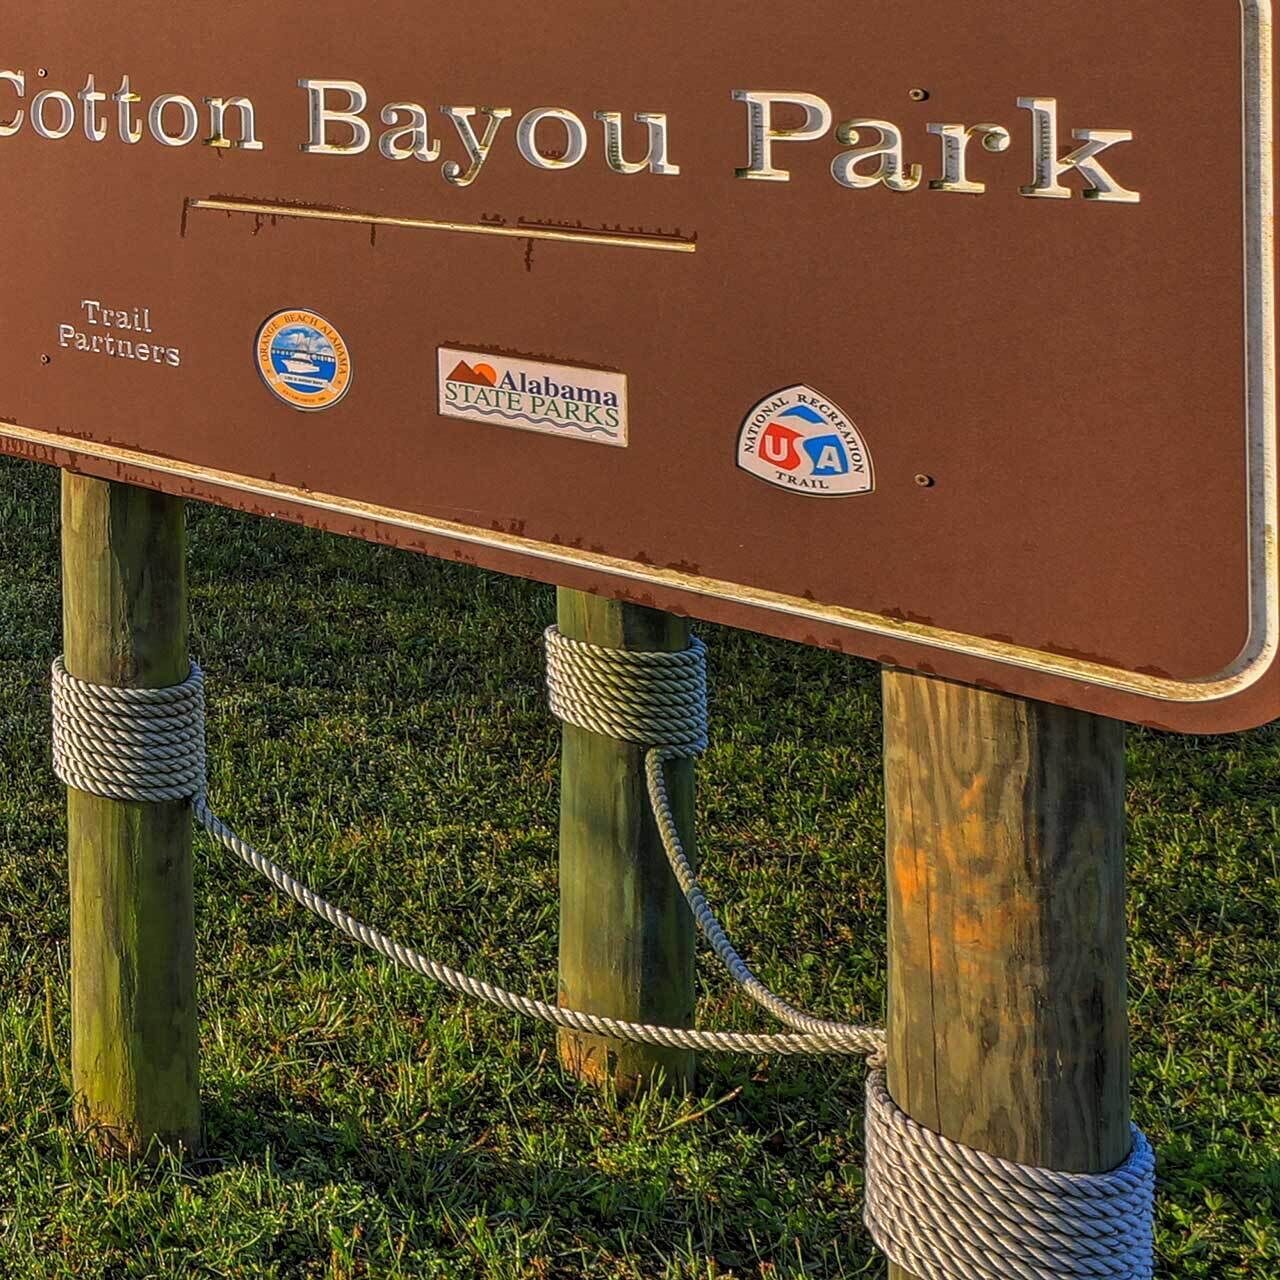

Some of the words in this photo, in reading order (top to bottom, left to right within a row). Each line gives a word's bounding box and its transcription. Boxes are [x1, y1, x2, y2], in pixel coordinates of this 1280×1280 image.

[298, 78, 681, 187] Bayou
[731, 89, 1140, 203] Park
[80, 299, 152, 333] Trail
[58, 323, 181, 367] Partners
[260, 322, 279, 361] ORANGE
[284, 314, 318, 326] BEACH
[320, 325, 347, 375] ALABAMA
[445, 382, 523, 412] STATE
[530, 395, 619, 428] PARKS
[499, 370, 619, 407] Alabama
[744, 396, 789, 454] NATIONAL
[797, 393, 864, 474] RECREATION
[761, 422, 848, 474] USA
[776, 471, 829, 489] TRAIL
